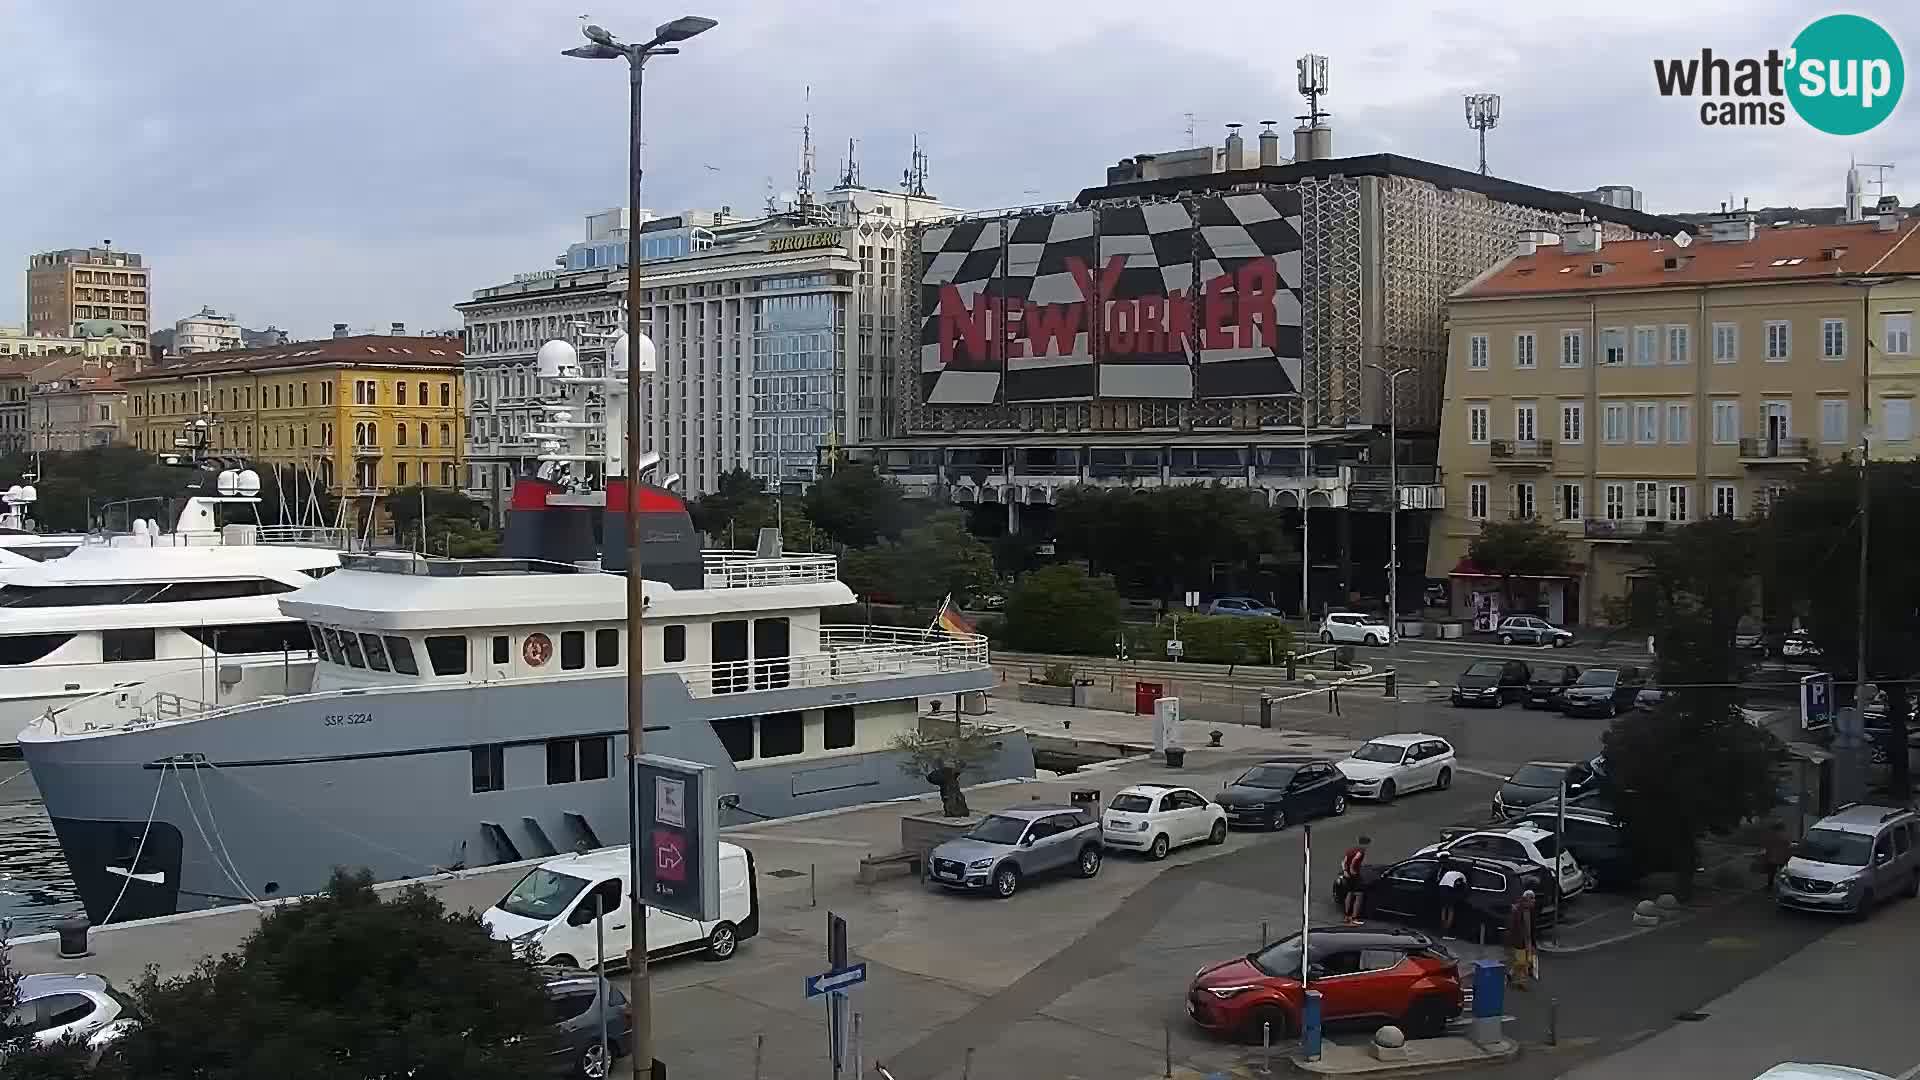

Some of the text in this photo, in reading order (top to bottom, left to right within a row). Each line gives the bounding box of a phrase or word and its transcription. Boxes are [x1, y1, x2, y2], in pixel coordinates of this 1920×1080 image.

[767, 231, 840, 252] EUROHERC
[939, 256, 1277, 363] NEW YORKER
